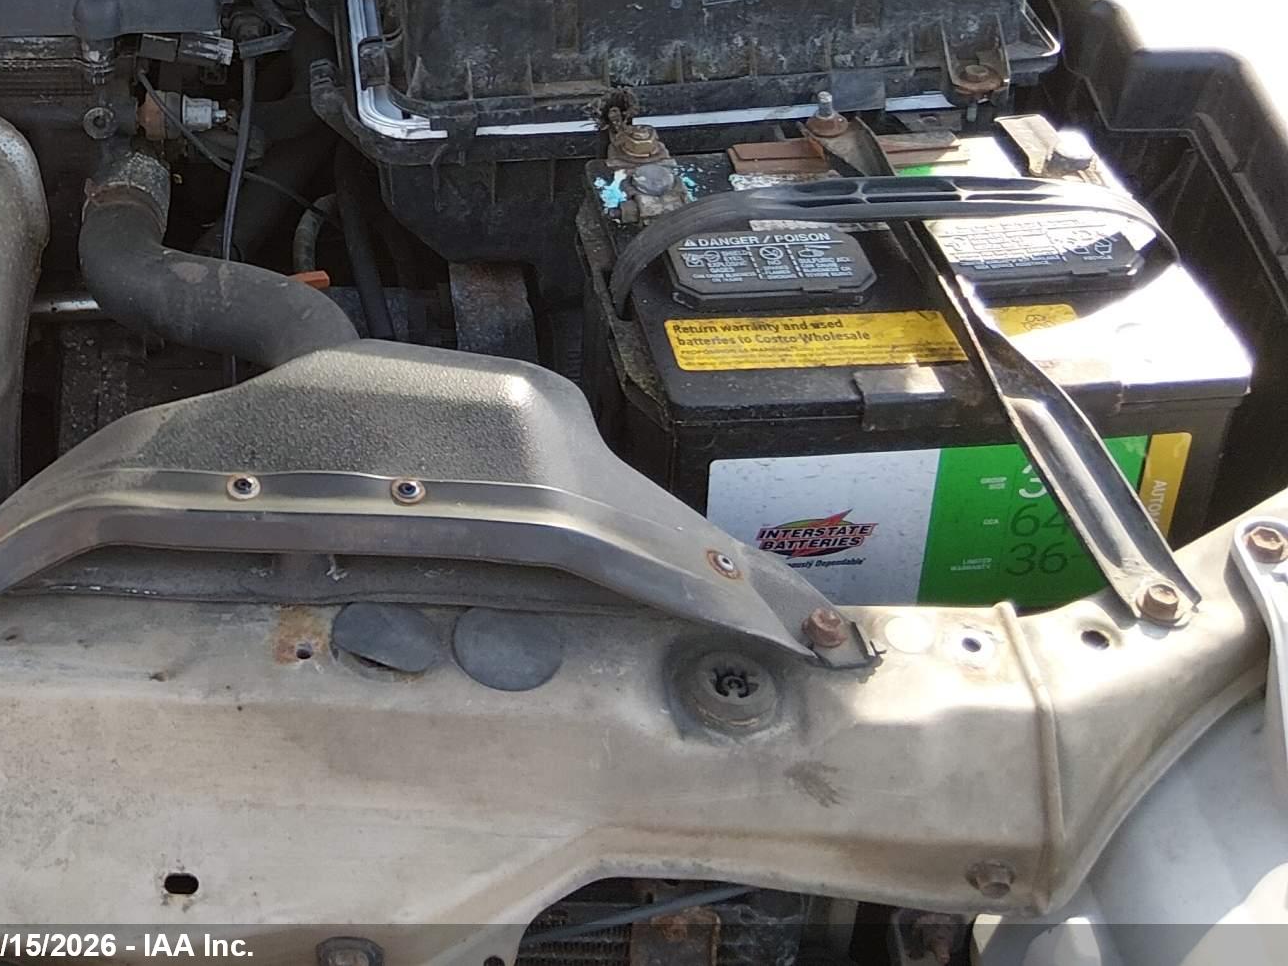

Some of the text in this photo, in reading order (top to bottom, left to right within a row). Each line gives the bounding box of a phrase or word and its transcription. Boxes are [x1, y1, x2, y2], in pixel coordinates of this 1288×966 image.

[698, 235, 759, 247] DANGER
[774, 232, 831, 243] POISON
[673, 318, 844, 334] Return warranty and used
[677, 331, 871, 346] batteries to Costco Wholesale
[1018, 464, 1048, 499] 3
[1010, 502, 1066, 537] 64
[759, 525, 873, 539] INTERSTATE
[762, 535, 862, 550] BATTERIES
[815, 557, 864, 568] Dependable
